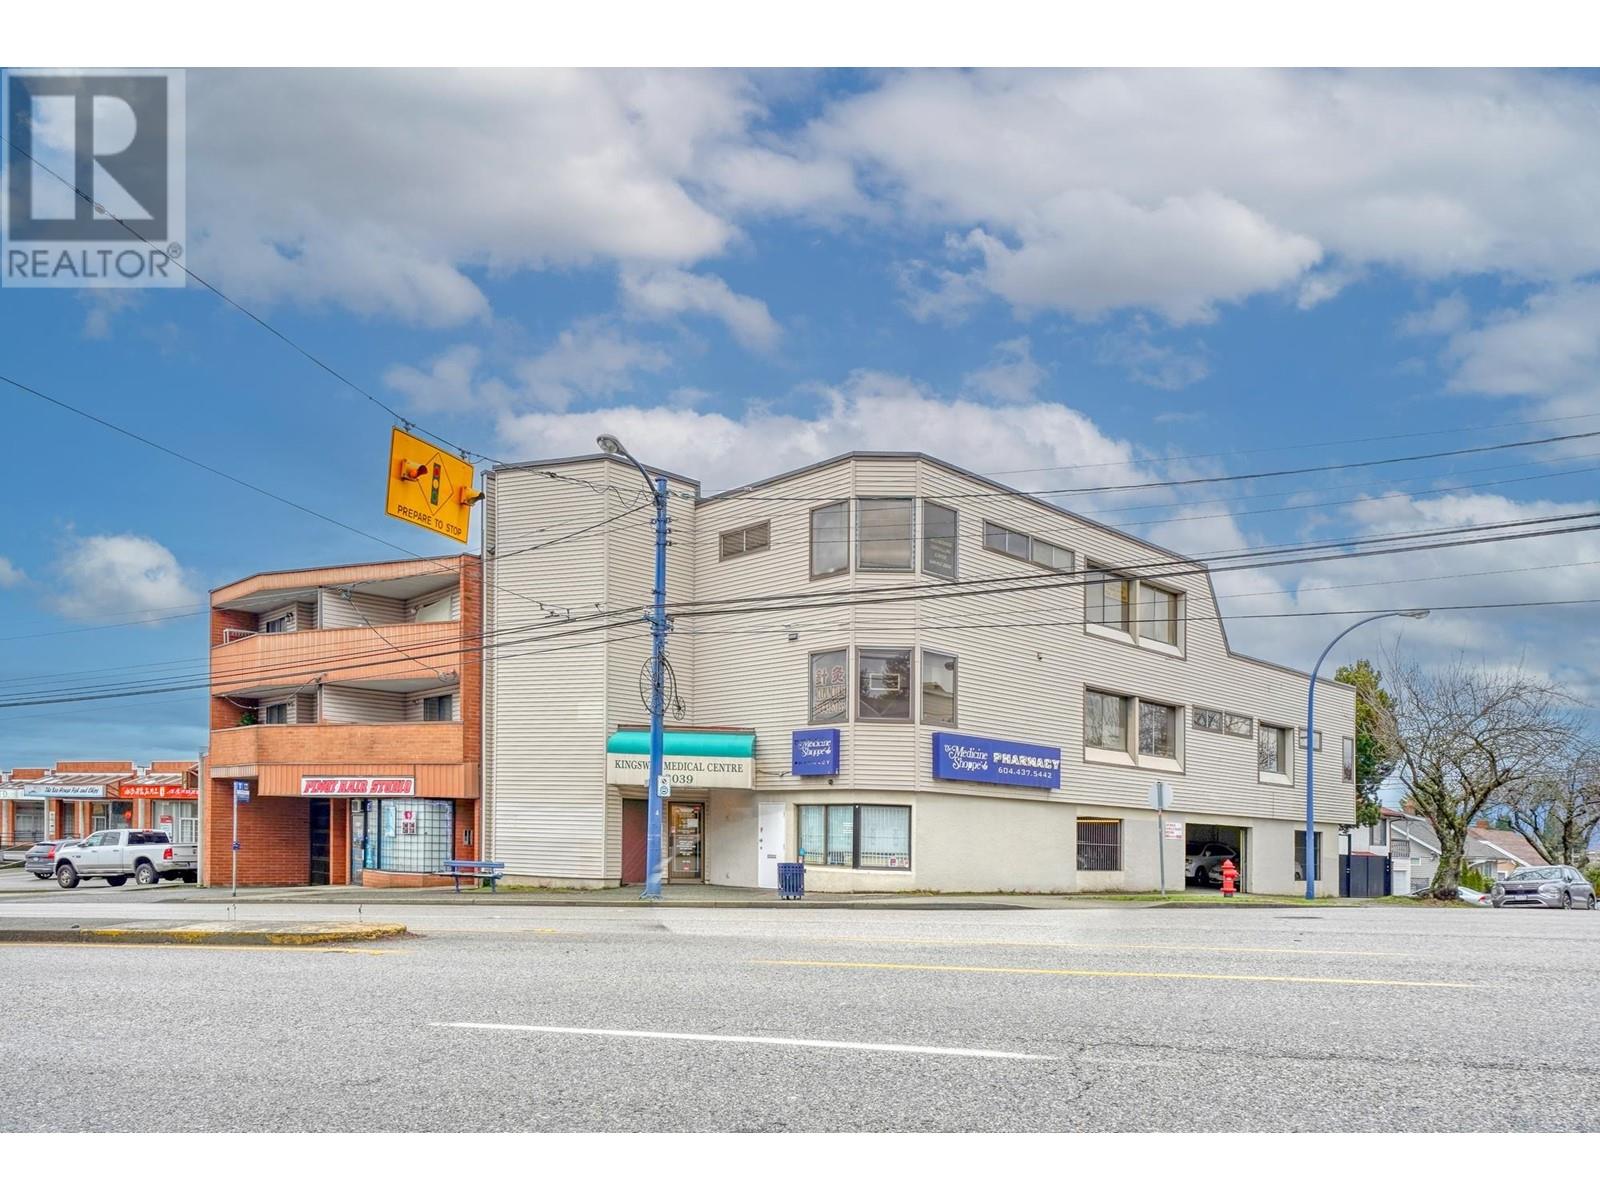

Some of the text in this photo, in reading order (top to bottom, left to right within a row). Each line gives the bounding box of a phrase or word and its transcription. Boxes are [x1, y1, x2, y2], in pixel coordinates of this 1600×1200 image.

[397, 505, 462, 535] PREPARE TO STOP
[949, 745, 988, 760] Medicine
[615, 760, 743, 773] KINGSW MEDICAL CENTRE
[993, 752, 1060, 769] PHARMACY
[998, 767, 1052, 779] 604.437.5442
[338, 780, 368, 793] HAIR
[370, 780, 412, 793] STUDIO
